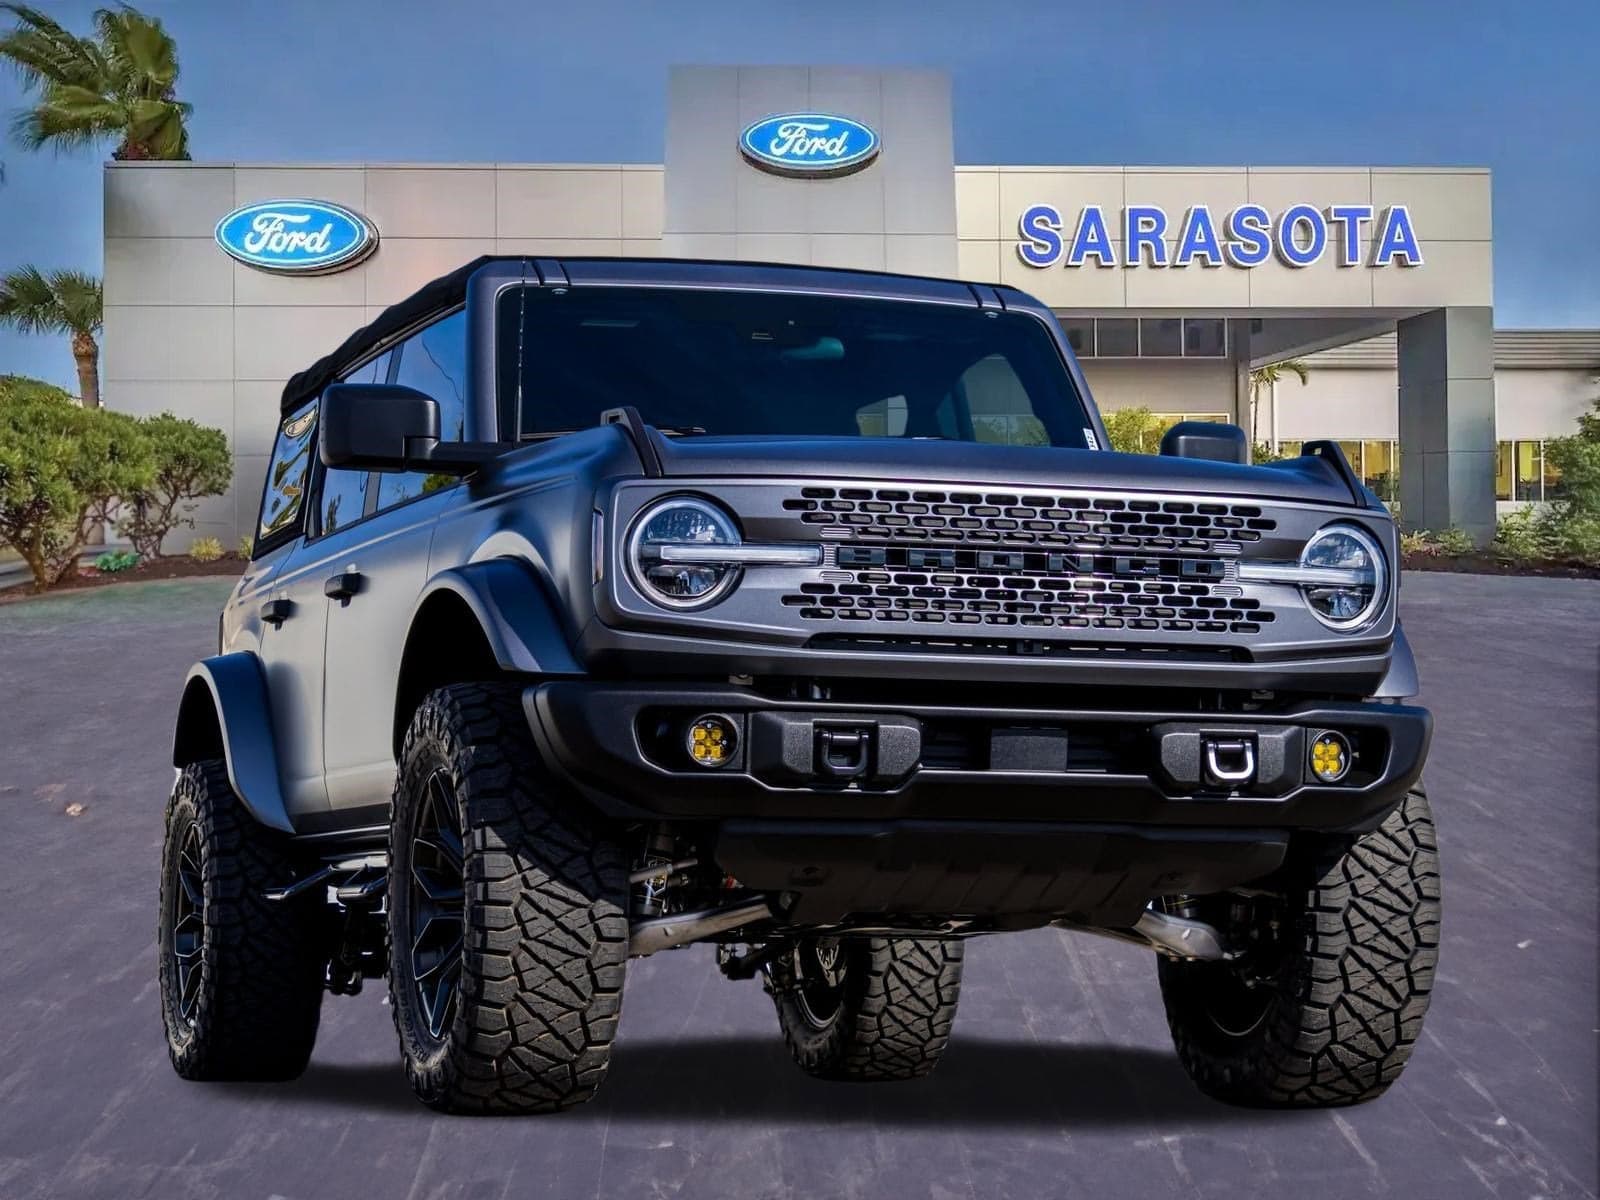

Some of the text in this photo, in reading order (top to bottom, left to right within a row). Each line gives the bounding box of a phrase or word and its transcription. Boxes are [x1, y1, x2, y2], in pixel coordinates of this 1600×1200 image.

[770, 122, 849, 156] Ford
[244, 212, 333, 254] Ford
[1017, 203, 1424, 269] SARASOTA
